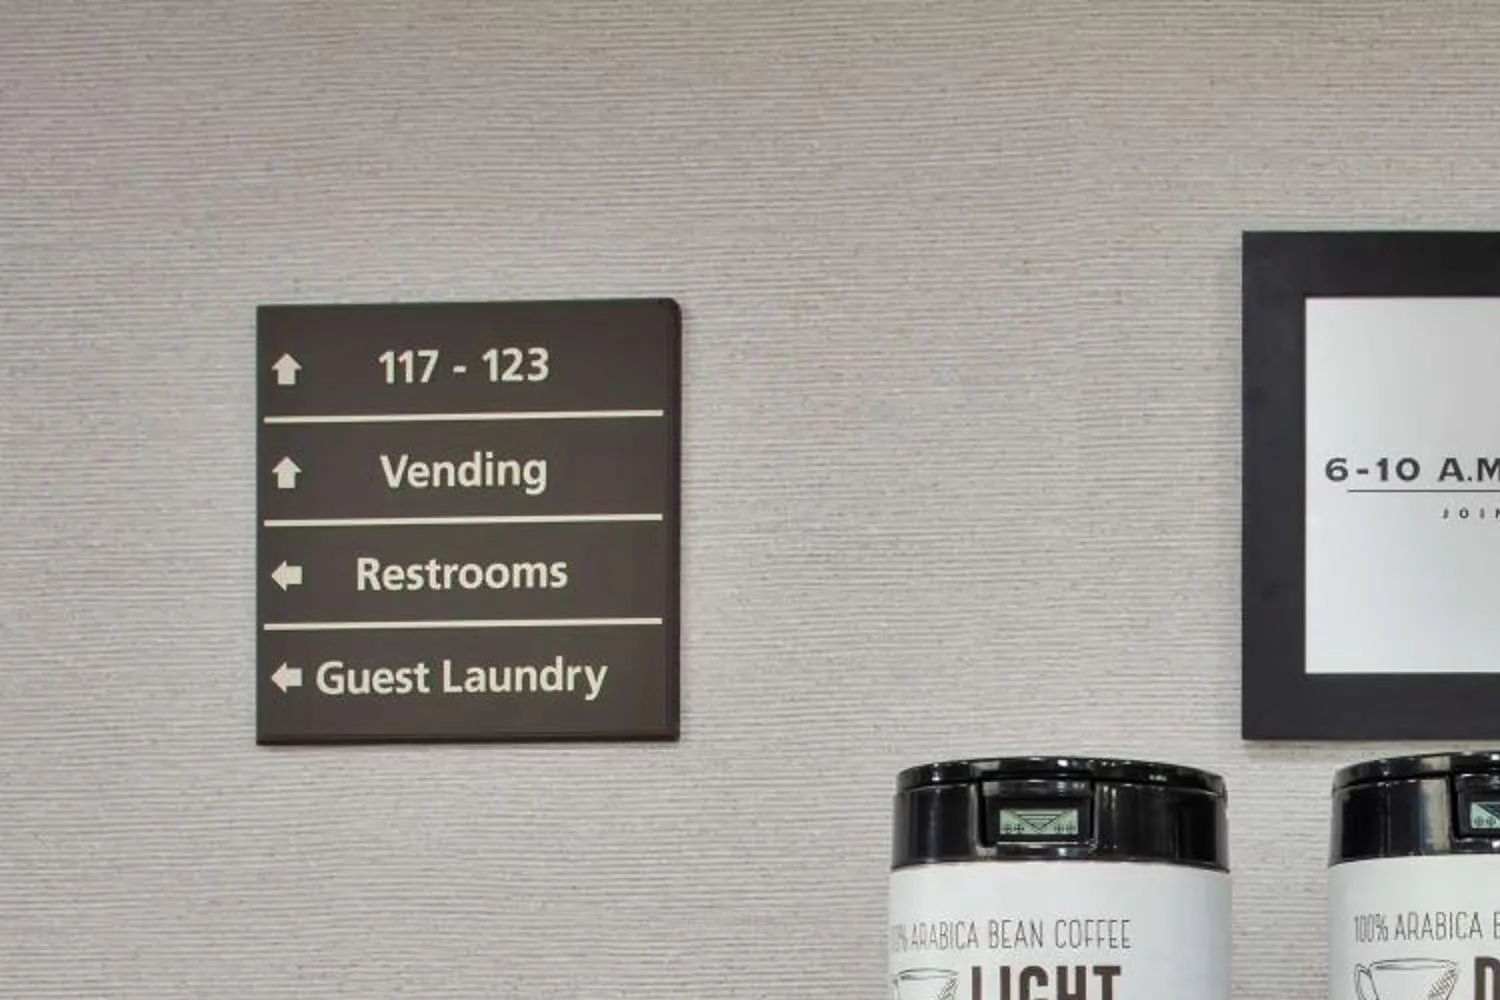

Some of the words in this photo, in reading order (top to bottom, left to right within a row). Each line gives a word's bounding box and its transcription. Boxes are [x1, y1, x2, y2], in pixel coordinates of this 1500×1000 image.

[378, 349, 439, 384] 117
[482, 347, 550, 382] 123
[379, 451, 548, 496] Vending
[1325, 457, 1421, 483] 6-10
[356, 557, 568, 591] Restrooms
[316, 660, 431, 695] Guest
[442, 655, 608, 701] Laundry
[911, 921, 980, 951] ARABICA
[988, 919, 1044, 949] BEAN
[1054, 919, 1132, 950] COFFEE
[1353, 913, 1389, 943] 100%
[1394, 911, 1484, 942] ARABICA
